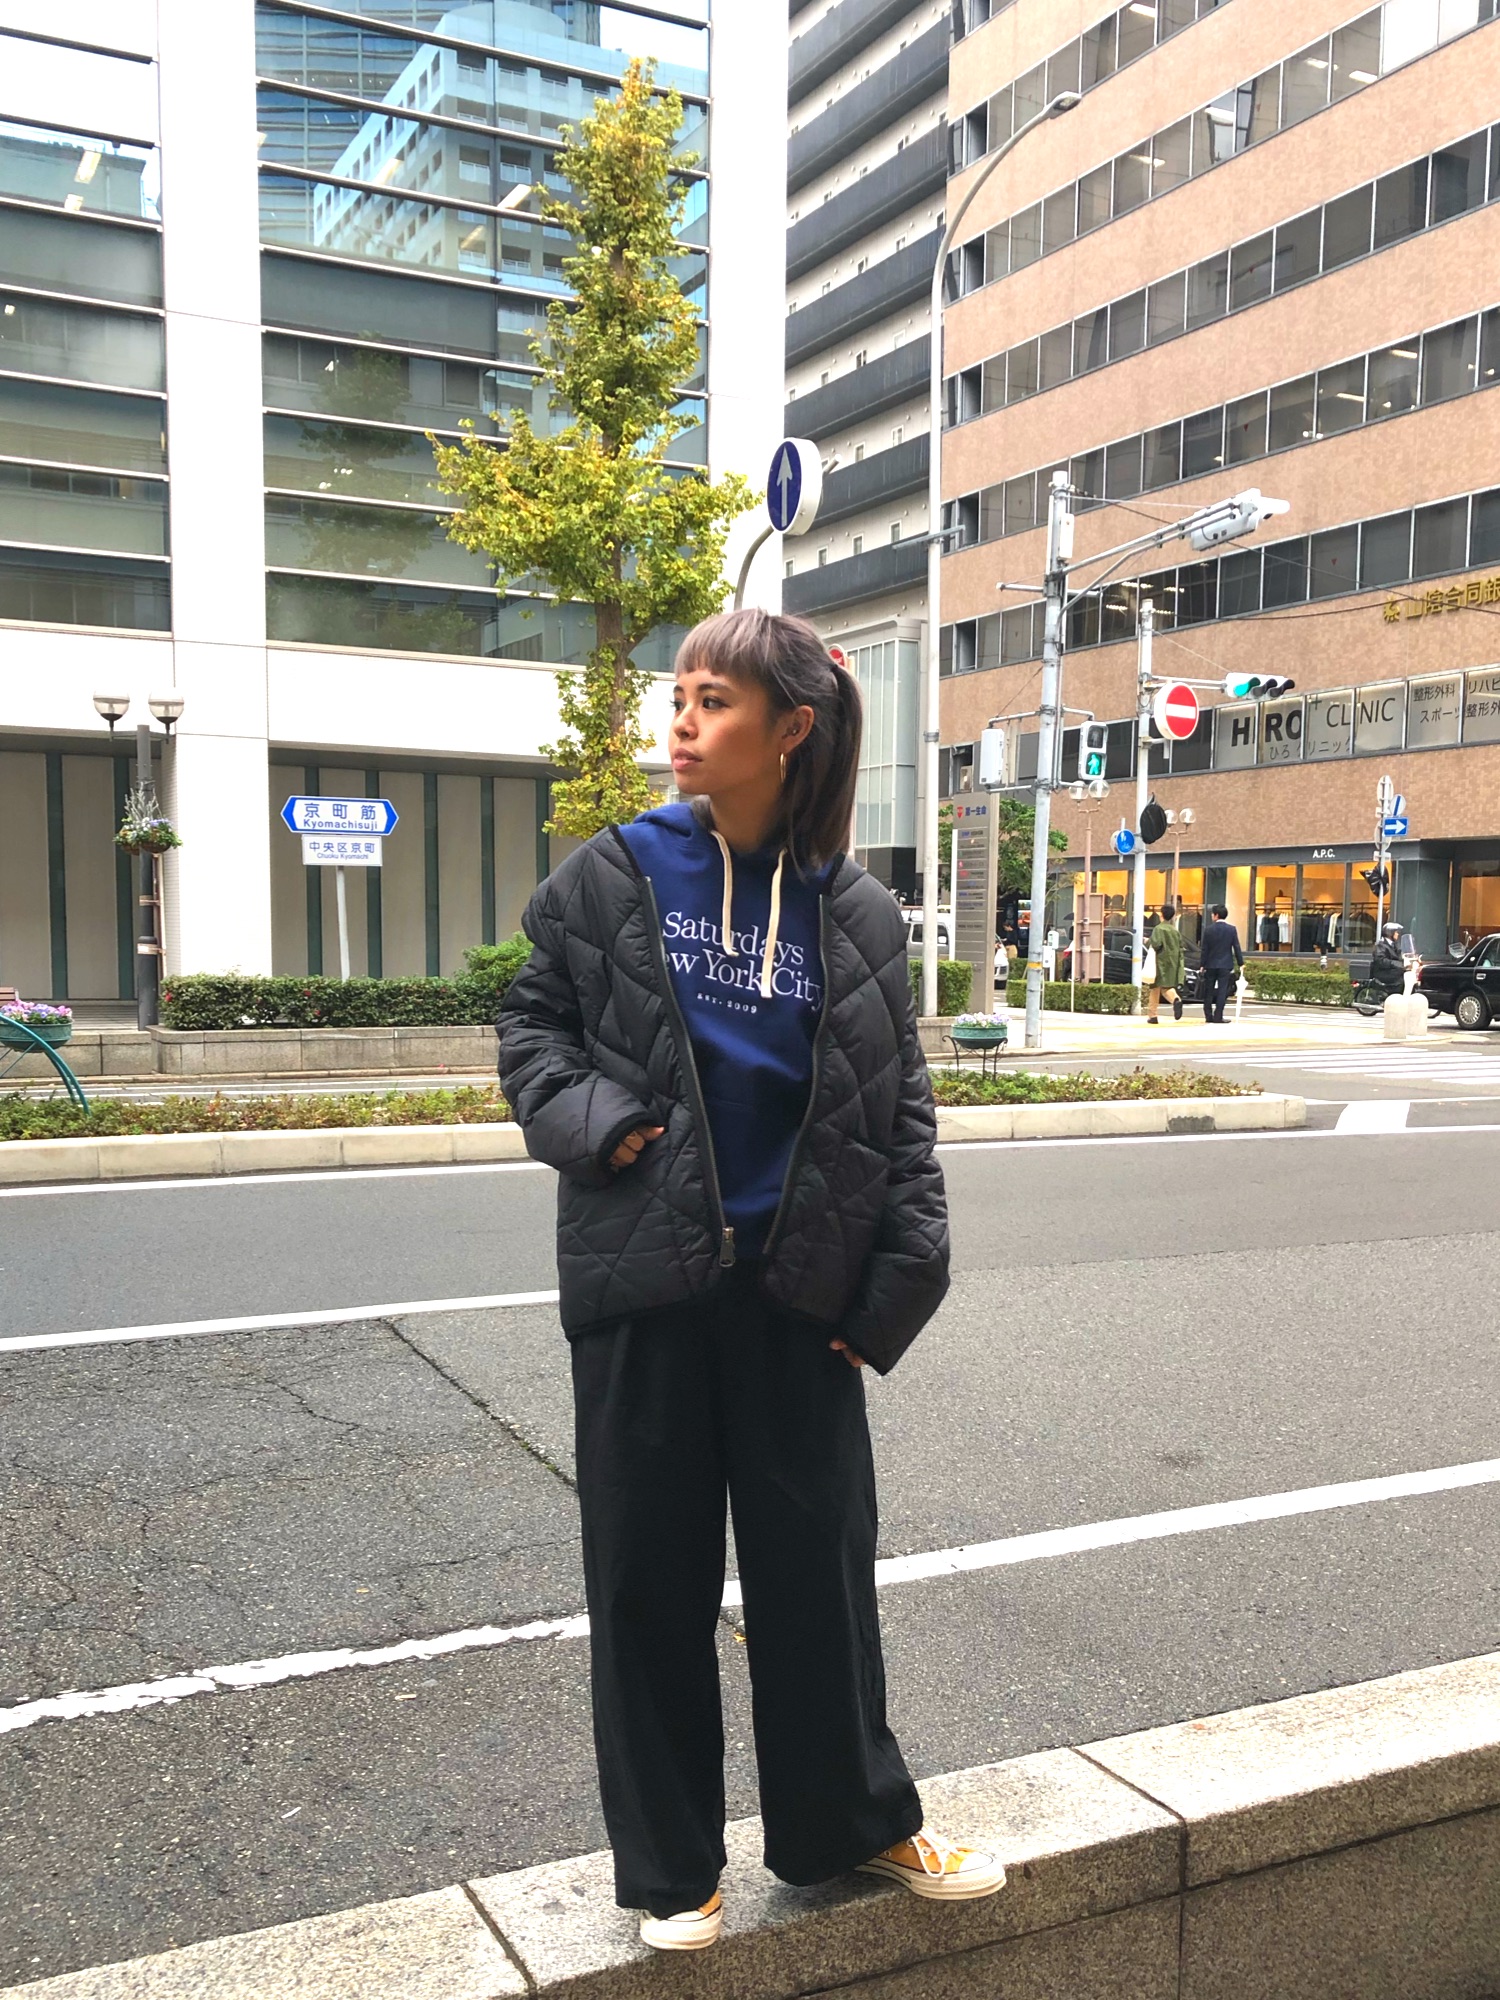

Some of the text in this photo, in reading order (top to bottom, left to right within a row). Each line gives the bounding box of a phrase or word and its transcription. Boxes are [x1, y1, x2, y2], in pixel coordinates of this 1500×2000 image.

[1413, 683, 1455, 702] 整形外科
[1326, 698, 1396, 728] CLNIC
[304, 803, 376, 820] 京町筋
[303, 819, 377, 830] Kyomachisuji
[309, 841, 374, 853] 中央区京町
[1312, 848, 1335, 858] A.P.C.
[663, 912, 804, 967] Saturdays
[702, 949, 762, 991] York
[771, 967, 823, 1012] City
[727, 1000, 757, 1014] 2009
